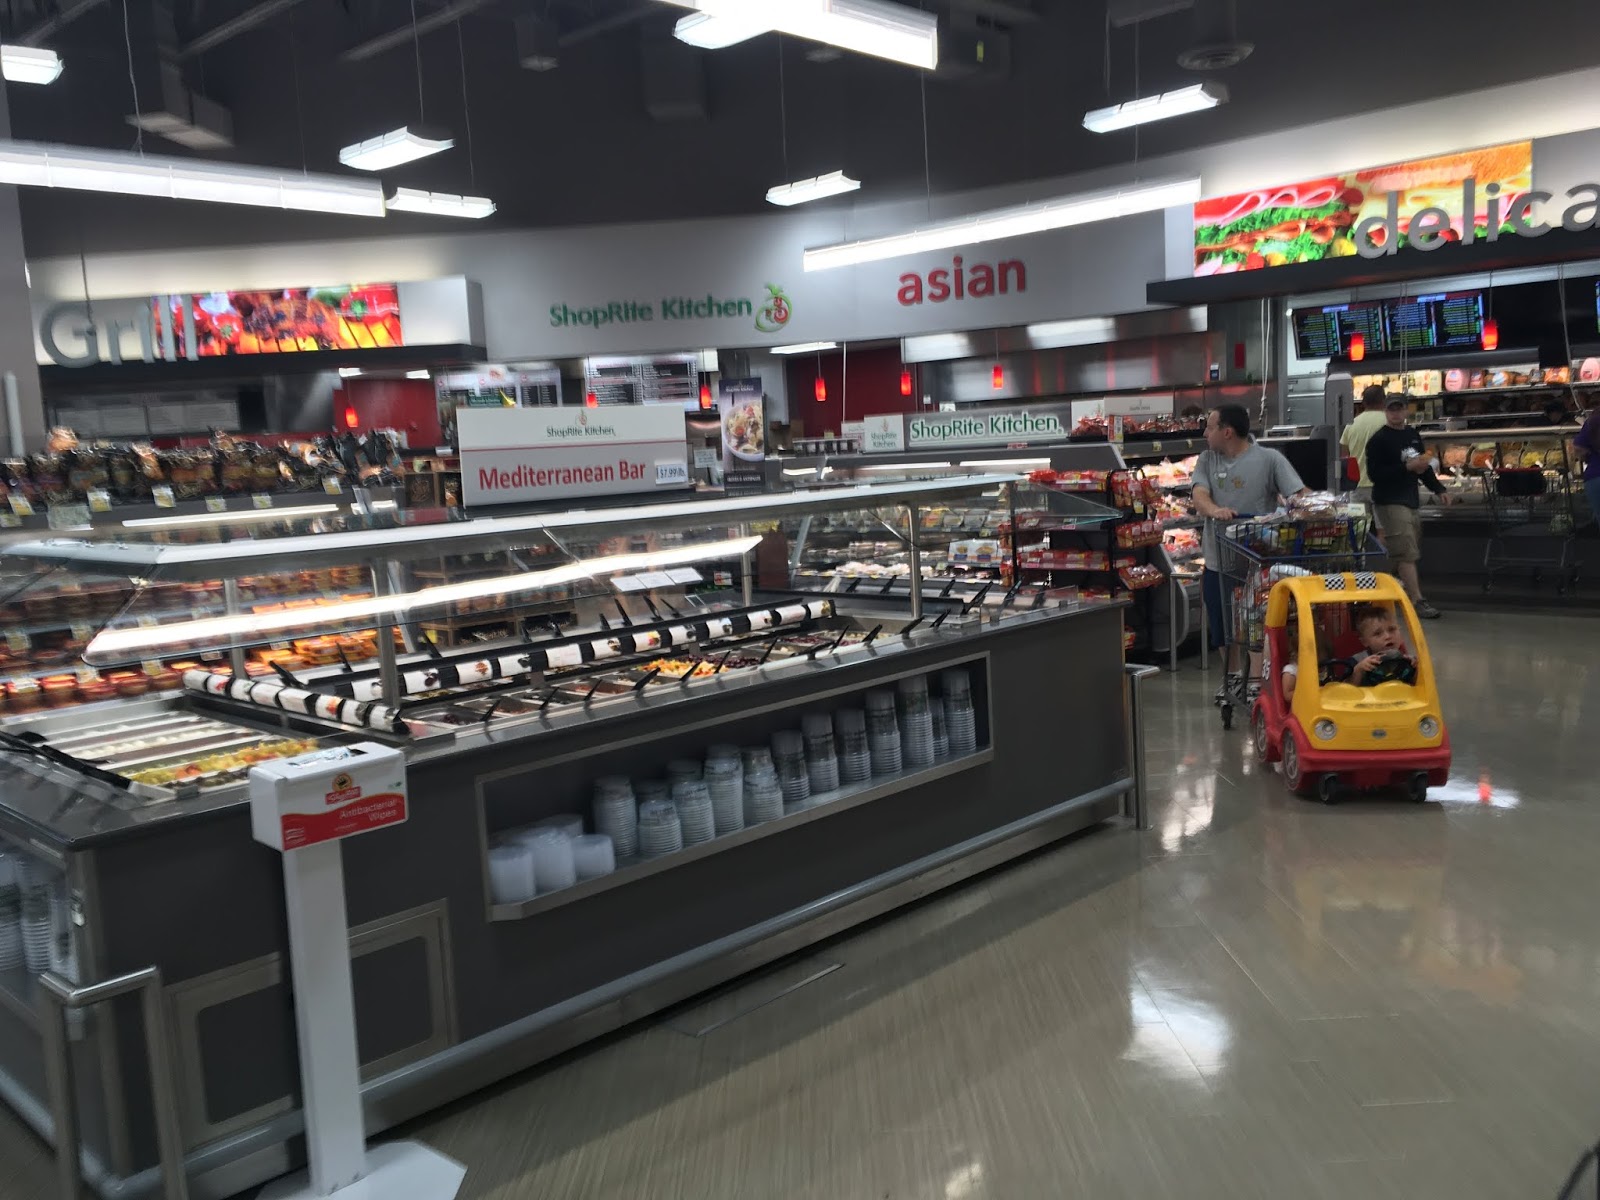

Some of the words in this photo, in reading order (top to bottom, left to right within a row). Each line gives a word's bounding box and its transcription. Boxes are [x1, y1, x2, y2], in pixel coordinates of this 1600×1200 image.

[1354, 175, 1600, 259] delica
[897, 255, 1027, 307] asian
[549, 299, 654, 329] ShopRite
[660, 295, 753, 320] Kitchen
[40, 293, 199, 368] Grill
[547, 425, 583, 438] ShopRite
[911, 416, 984, 441] ShopRite
[479, 463, 614, 490] Mediterranean
[619, 459, 646, 480] Bar
[339, 799, 397, 819] Antibacterial
[368, 809, 397, 821] Wipes
